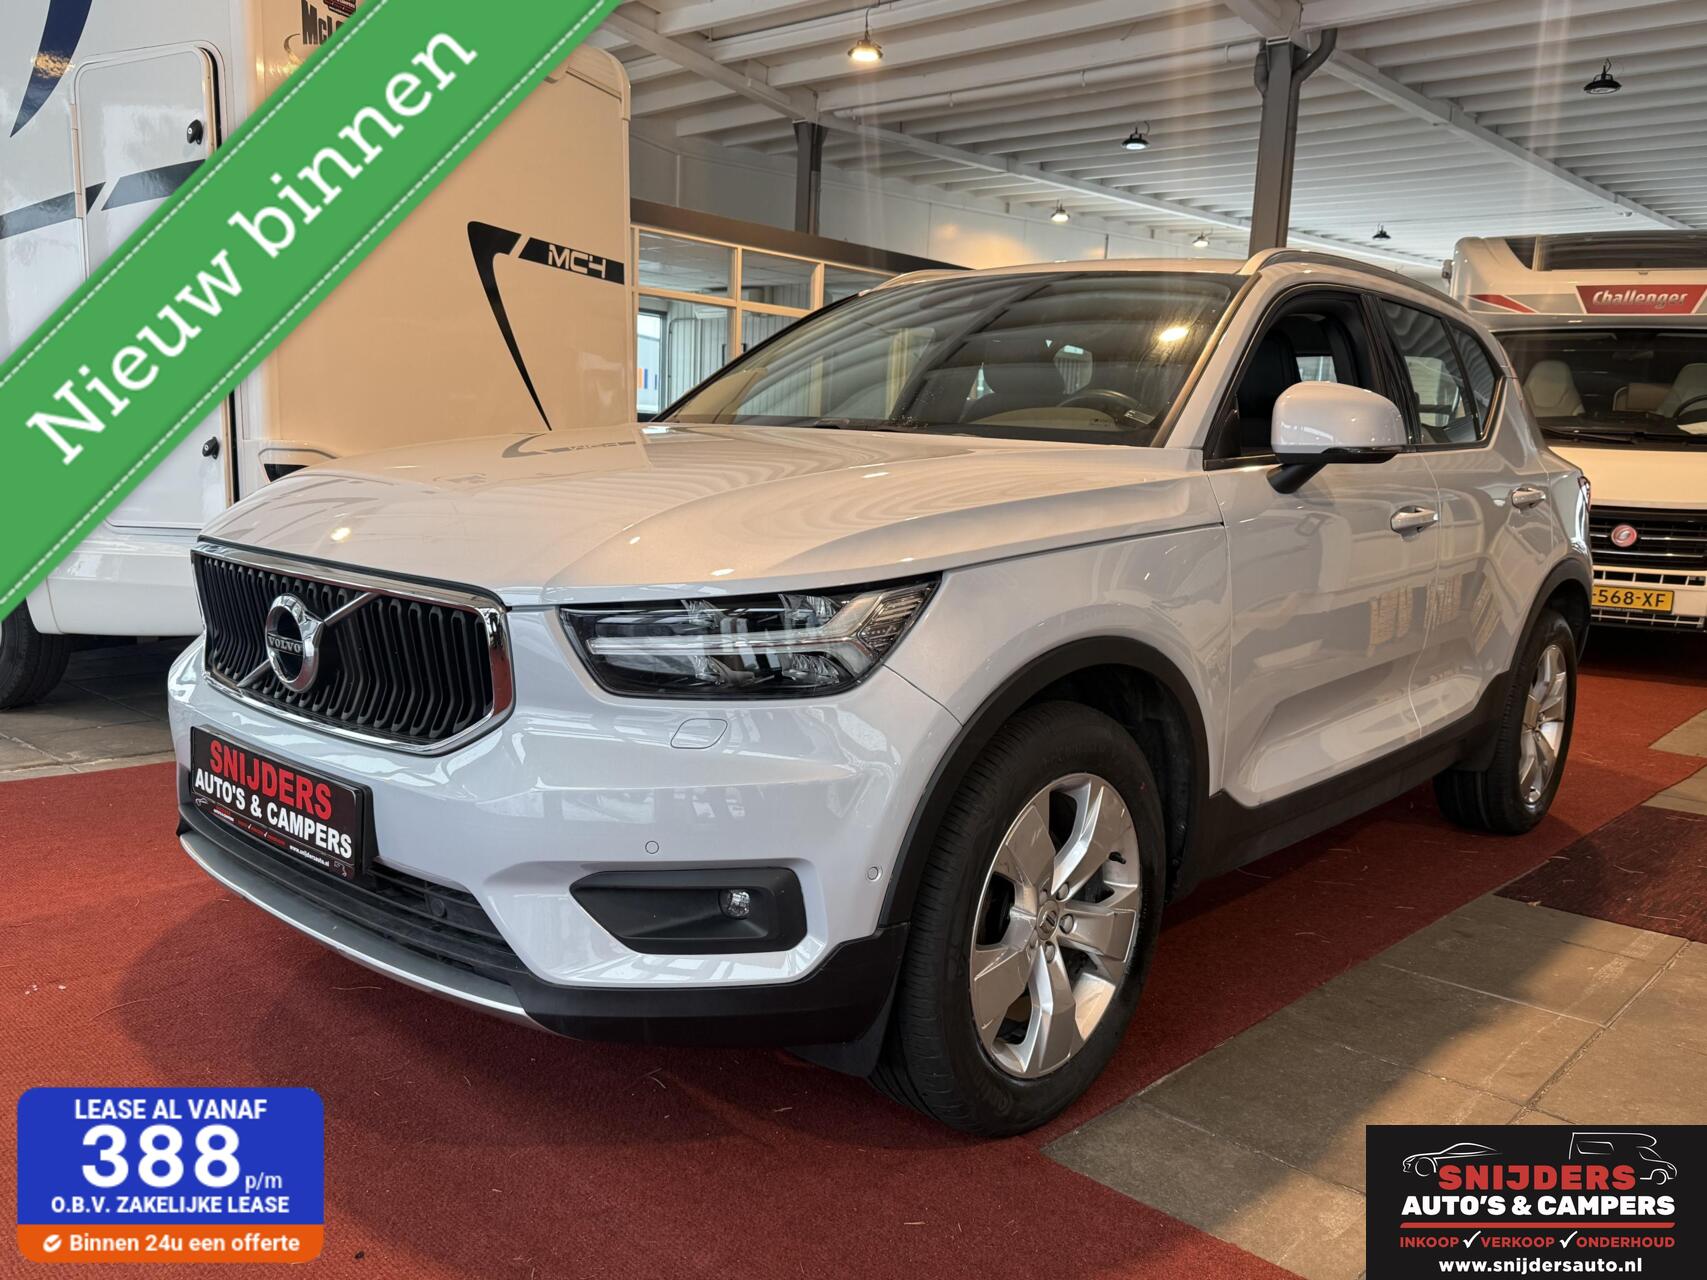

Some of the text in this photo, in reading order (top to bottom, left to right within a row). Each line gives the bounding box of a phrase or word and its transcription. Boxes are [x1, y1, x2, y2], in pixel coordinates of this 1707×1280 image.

[1592, 289, 1689, 310] Challenger
[268, 635, 301, 653] VOLVO
[210, 739, 332, 820] SNIJDERS
[195, 768, 246, 811] AUTO'S
[250, 794, 262, 819] &
[267, 801, 352, 859] CAMPERS
